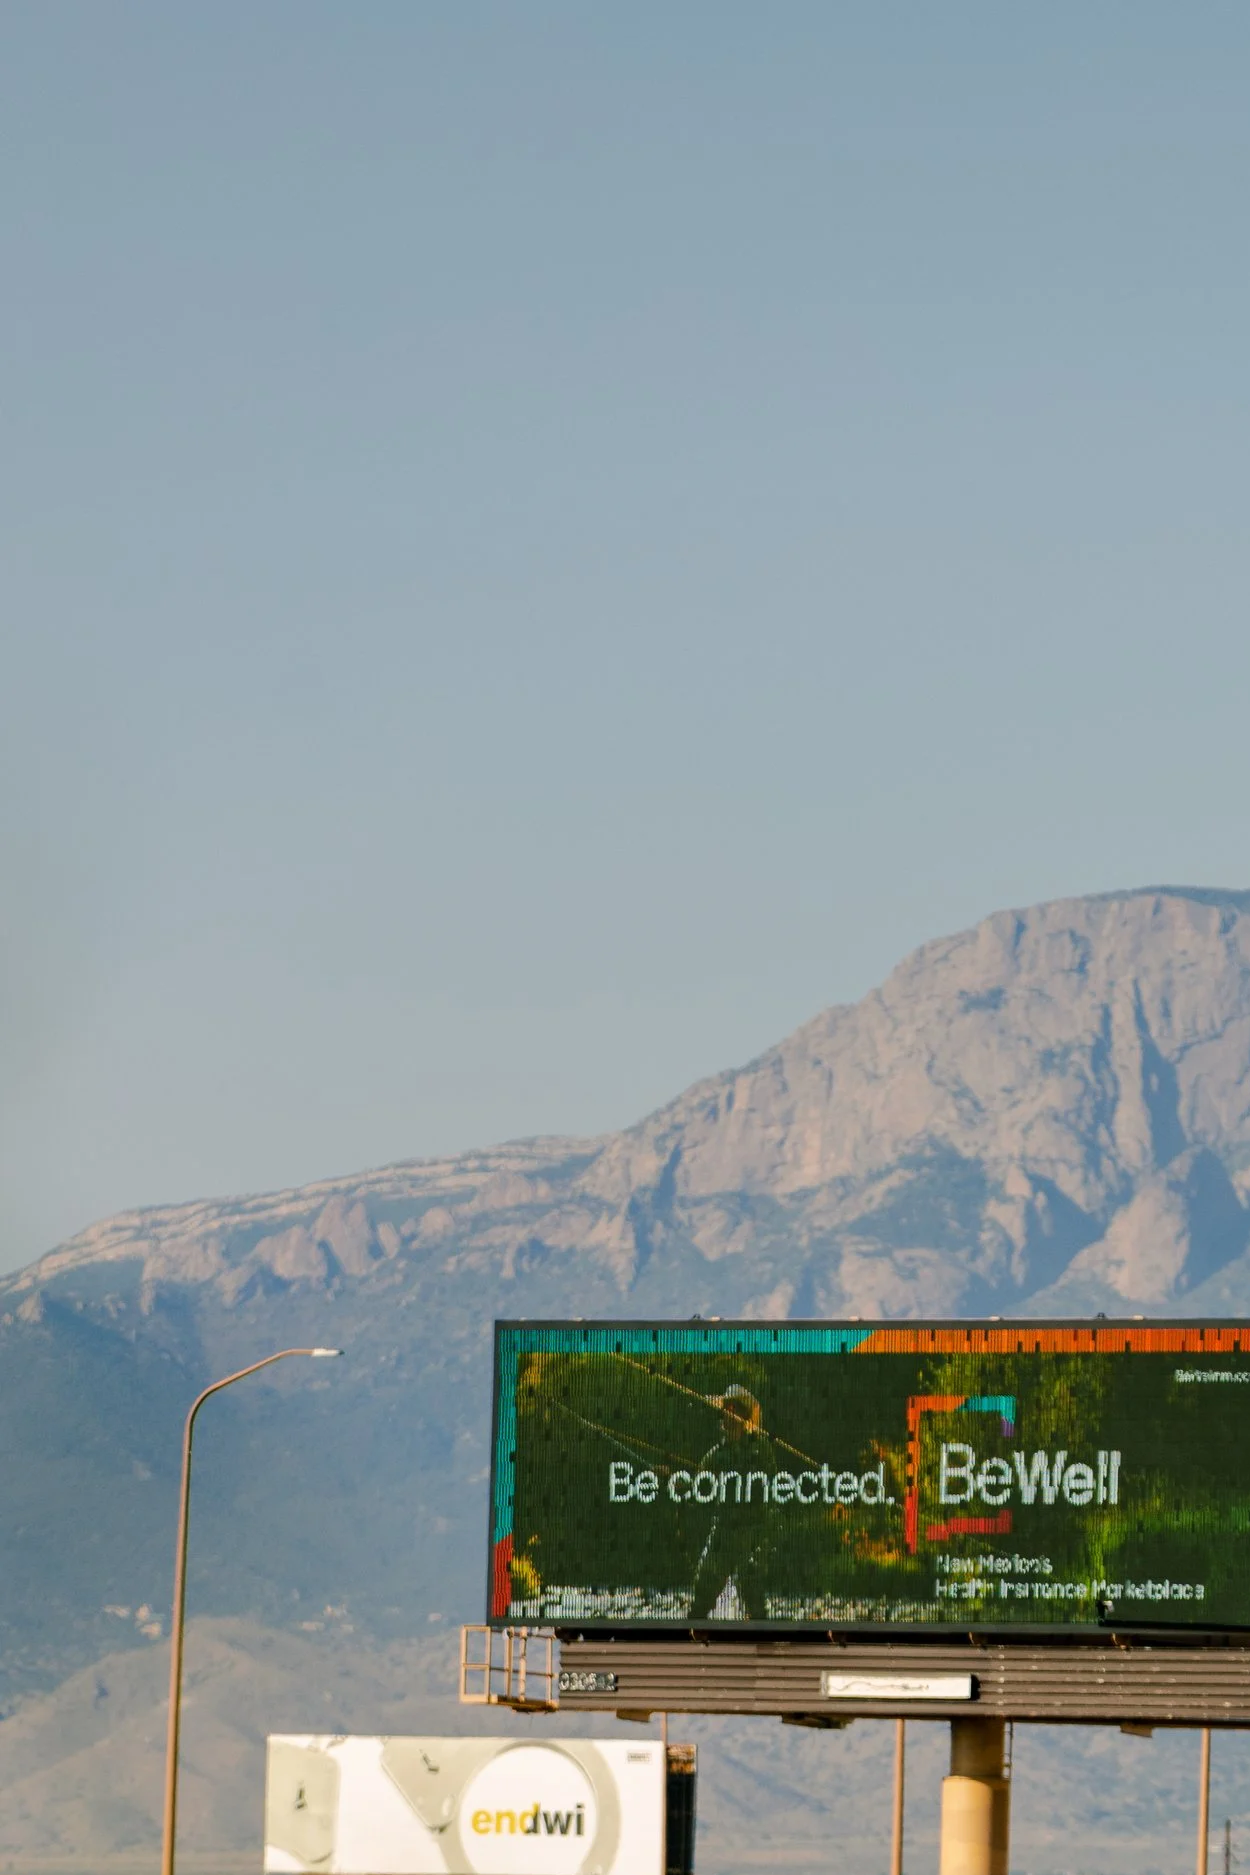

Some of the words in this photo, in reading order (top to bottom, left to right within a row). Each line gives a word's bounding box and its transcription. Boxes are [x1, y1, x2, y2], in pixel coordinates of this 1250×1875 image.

[609, 1461, 659, 1503] Be
[668, 1461, 896, 1504] connected.
[939, 1442, 1122, 1506] BeWell
[936, 1554, 975, 1573] New
[935, 1578, 994, 1599] Health
[1000, 1578, 1087, 1599] Insurance
[1091, 1579, 1205, 1601] Marketplace
[471, 1801, 585, 1836] endwi
